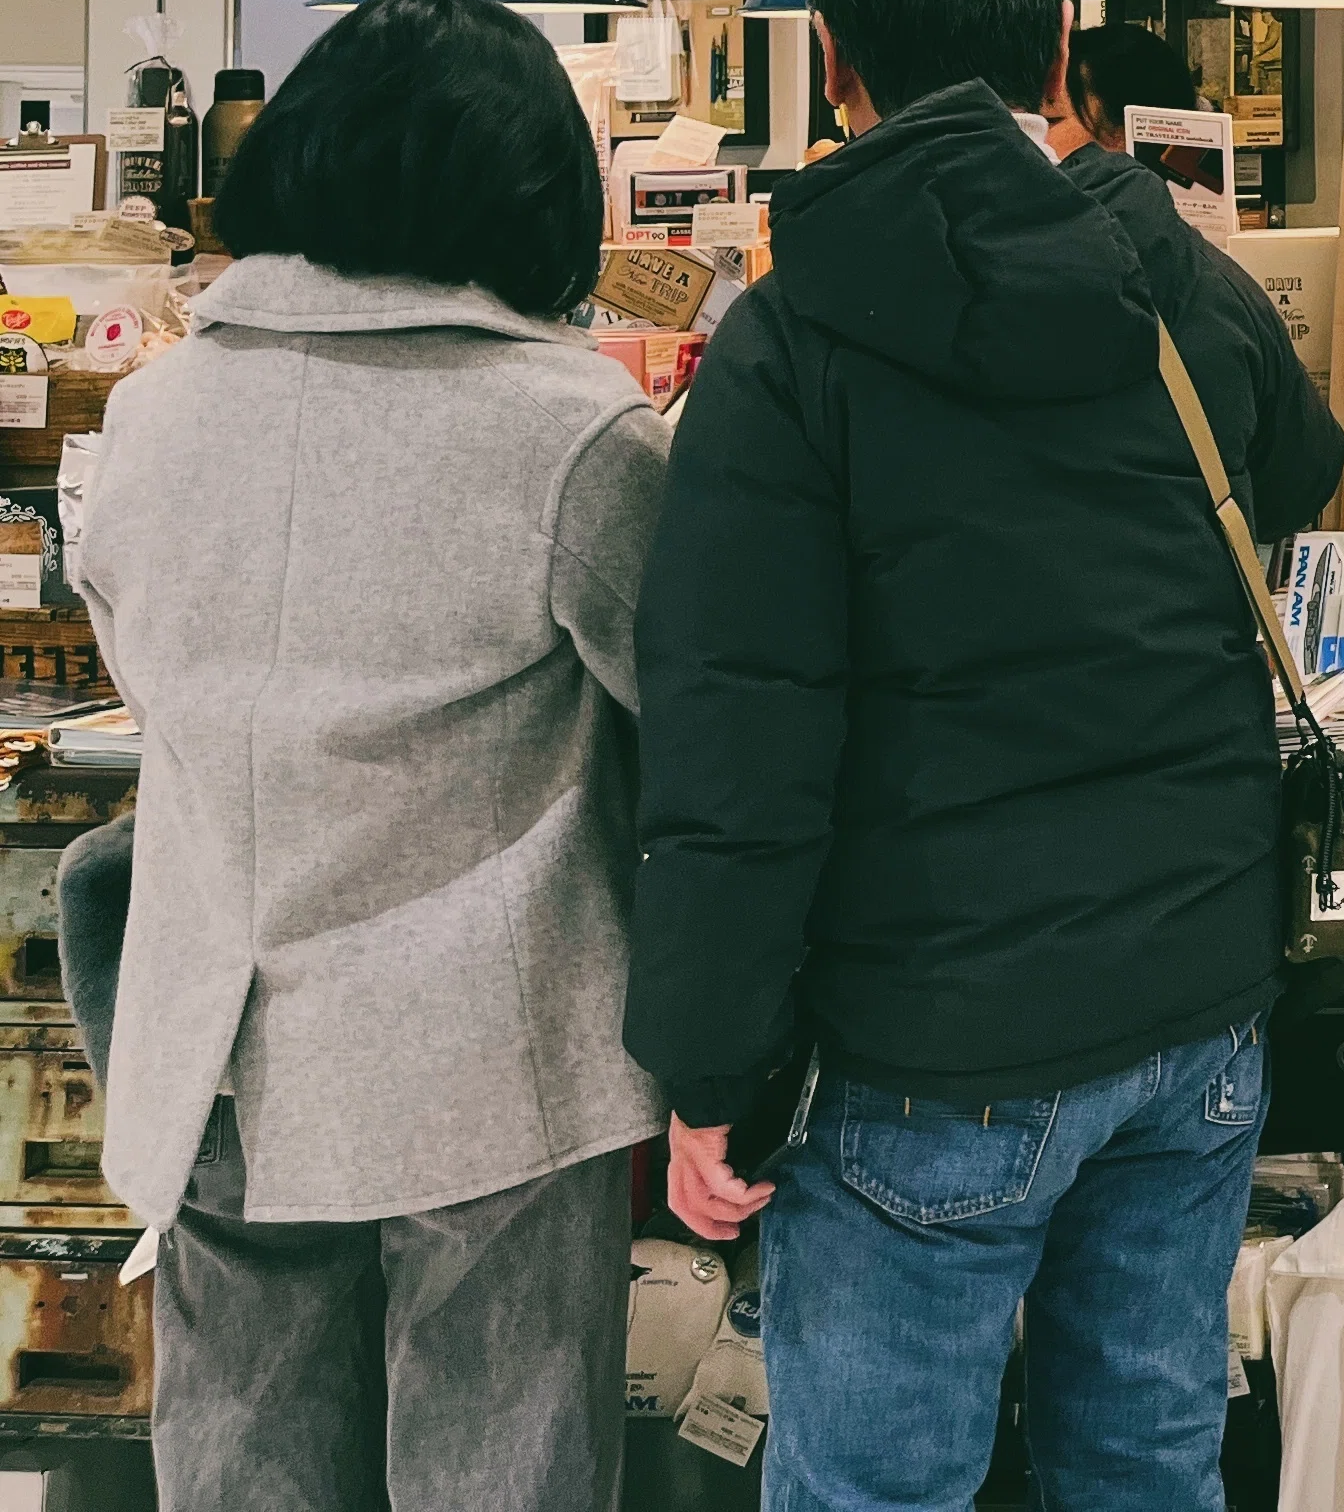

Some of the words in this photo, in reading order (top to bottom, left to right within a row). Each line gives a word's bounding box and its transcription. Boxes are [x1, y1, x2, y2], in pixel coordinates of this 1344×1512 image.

[626, 231, 651, 241] OPT
[652, 232, 665, 241] 90
[627, 249, 674, 281] HAVE
[675, 271, 690, 288] A
[650, 278, 689, 305] TRIP
[1265, 277, 1302, 291] HAVE
[1279, 295, 1290, 305] A
[1295, 545, 1310, 590] PAN
[1290, 591, 1304, 627] AM
